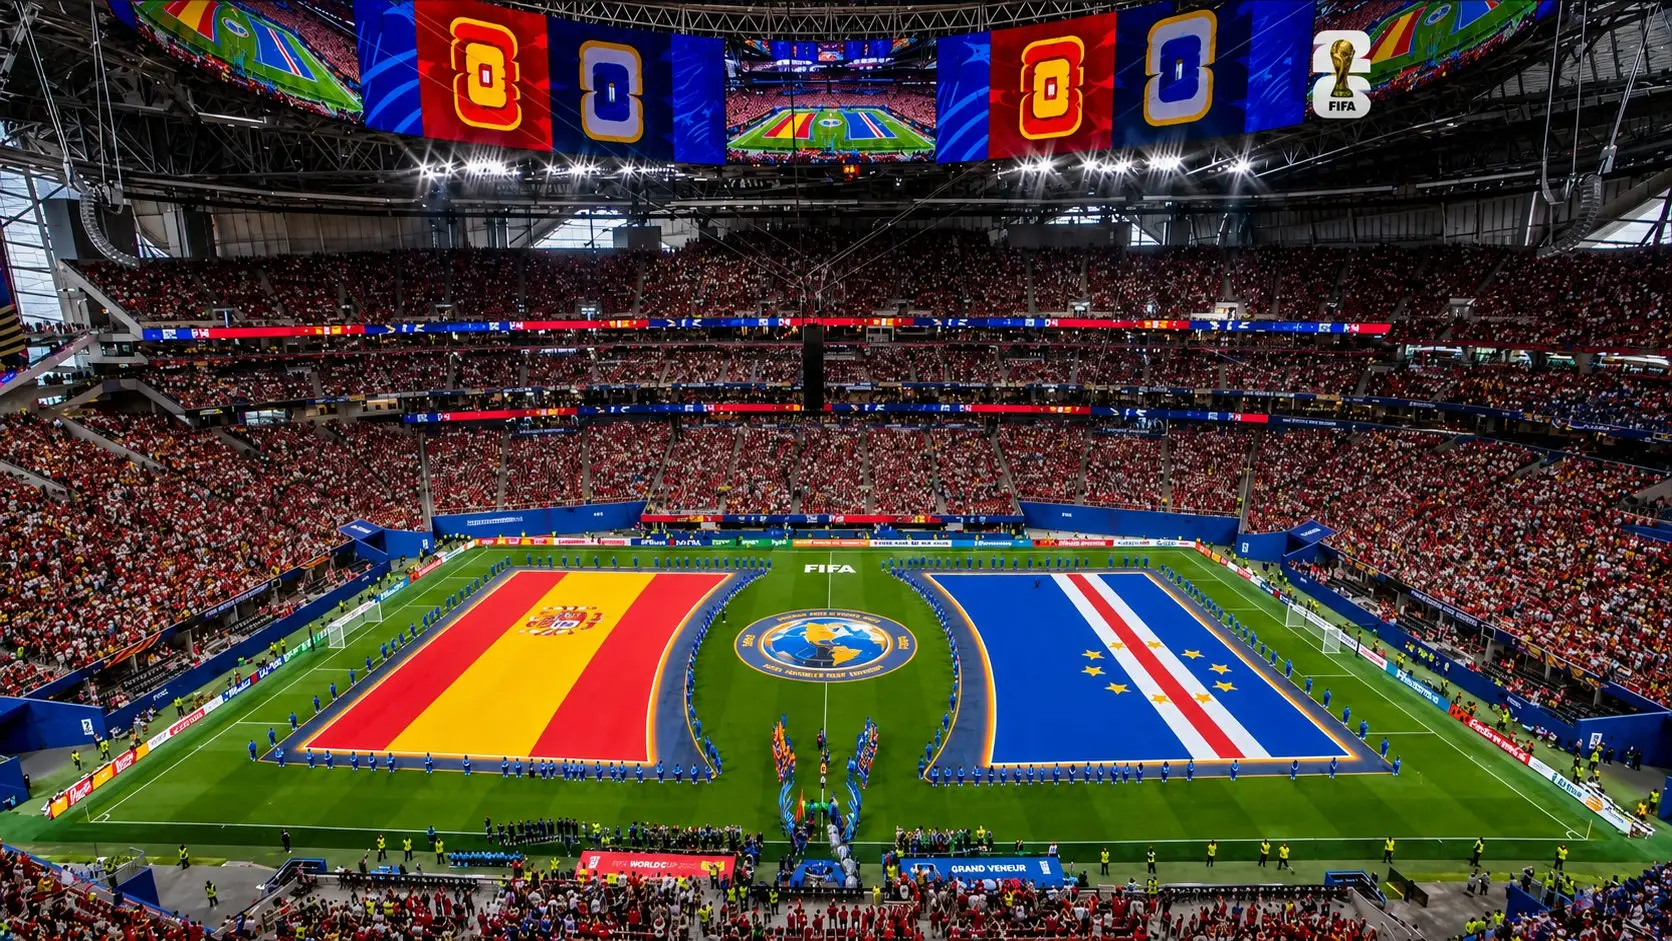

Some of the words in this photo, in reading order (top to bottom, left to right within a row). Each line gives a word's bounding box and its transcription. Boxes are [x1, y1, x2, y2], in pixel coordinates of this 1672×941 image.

[804, 564, 857, 574] FIFA
[951, 865, 985, 873] GRAND
[987, 864, 1026, 872] VENEUR
